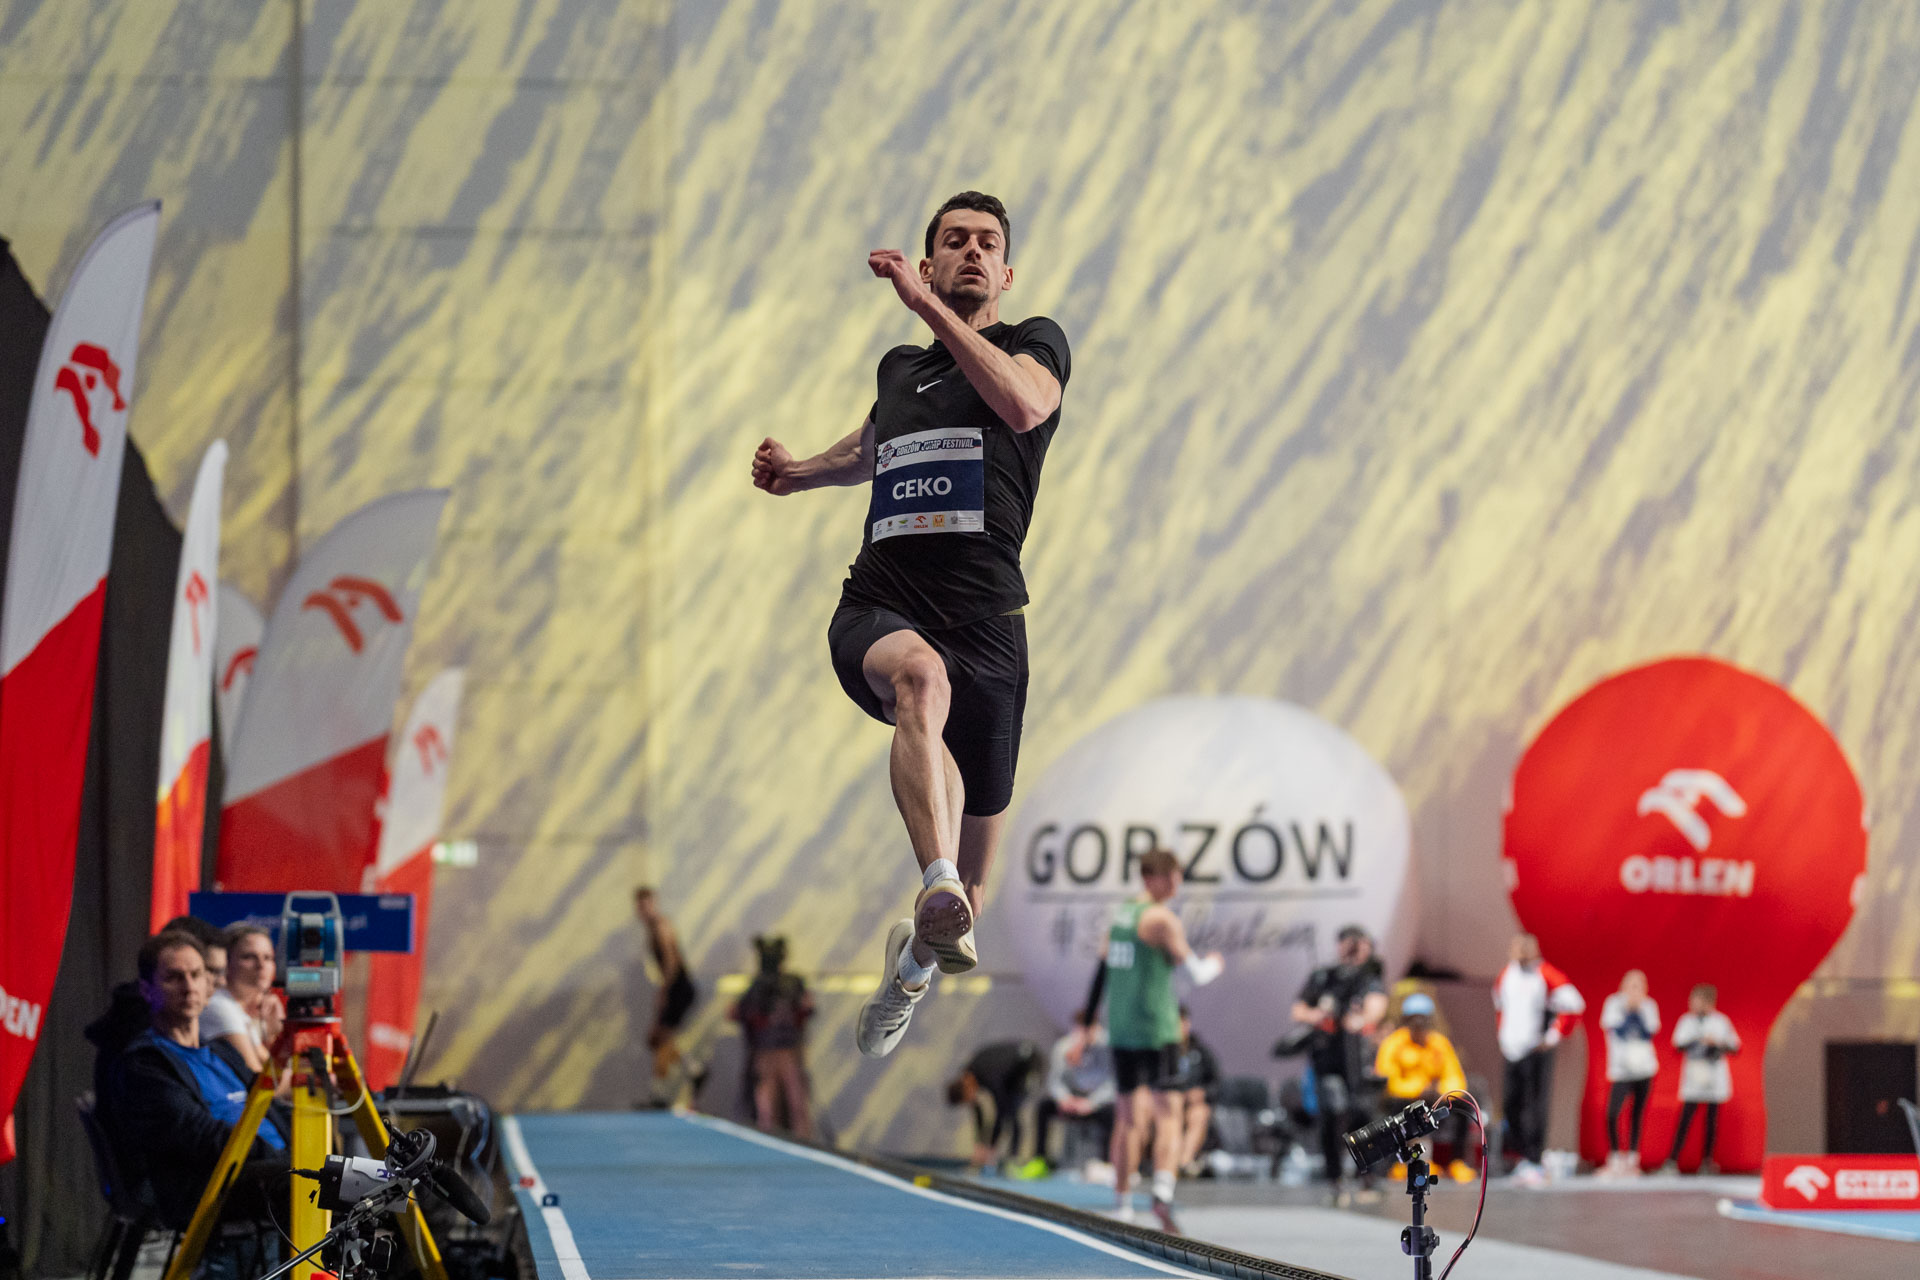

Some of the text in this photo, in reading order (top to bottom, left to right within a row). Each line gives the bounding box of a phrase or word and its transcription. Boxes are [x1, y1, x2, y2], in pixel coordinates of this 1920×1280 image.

[942, 438, 974, 449] FESTIVAL
[892, 476, 952, 500] CEKO
[1619, 854, 1756, 898] ORLEN
